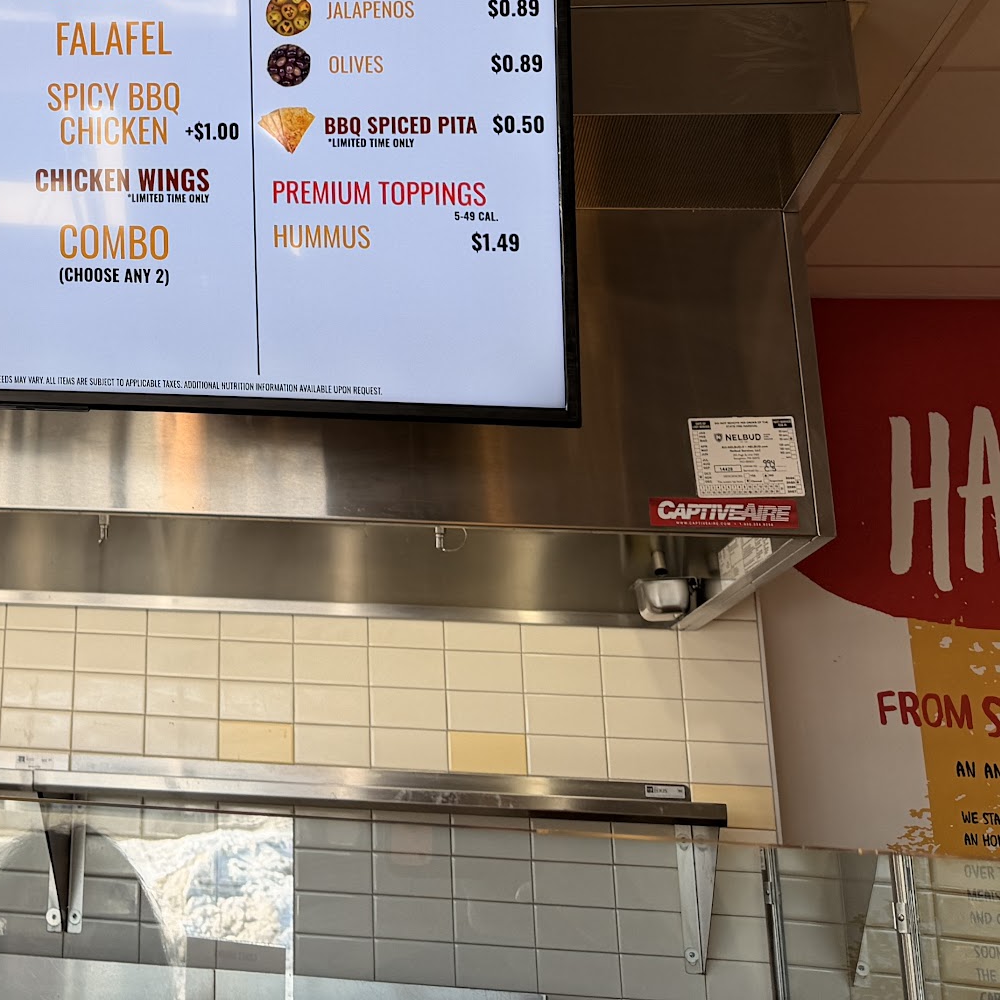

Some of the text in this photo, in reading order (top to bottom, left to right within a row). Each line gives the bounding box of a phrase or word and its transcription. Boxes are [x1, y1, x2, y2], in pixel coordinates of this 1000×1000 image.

[56, 21, 173, 56] FALAFEL
[328, 53, 543, 74] OLIVES $0.89
[47, 82, 181, 115] SPICY BBQ
[60, 116, 239, 146] CHICKEN +$1.00
[324, 114, 545, 137] BBQ SPICED PITA $0.50
[369, 138, 391, 148] TIME
[393, 138, 415, 148] ONLY
[35, 168, 210, 192] CHICKEN WINGS
[167, 193, 187, 203] TIME
[189, 194, 210, 204] ONLY
[272, 180, 487, 207] PREMIUM TOPPINGS
[454, 211, 499, 222] 5-49 CAL.
[59, 224, 170, 261] COMBO
[273, 224, 520, 253] HUMMUS $1.49
[59, 267, 170, 286] (CHOOSE ANY 2)
[14, 375, 27, 384] MAY
[45, 376, 56, 384] ALL
[57, 376, 75, 385] ITEMS
[76, 377, 88, 385] ARE
[89, 377, 115, 386] SUBJECT
[116, 378, 124, 386] TO
[125, 378, 161, 388] APPLICABLE
[183, 380, 220, 389] ADDITIONAL
[221, 381, 254, 391] NUTRITION
[255, 382, 298, 392] INFORMATION
[299, 384, 332, 394] AVAILABLE
[333, 385, 352, 394] UPON
[725, 433, 761, 441] NELBUD
[889, 406, 1000, 591] HA
[877, 690, 973, 730] FROM
[956, 761, 976, 778] AN
[961, 811, 979, 825] WE
[964, 832, 1000, 847] AN HO
[964, 864, 995, 880] OVER
[970, 910, 993, 925] AND
[976, 968, 997, 983] THE
